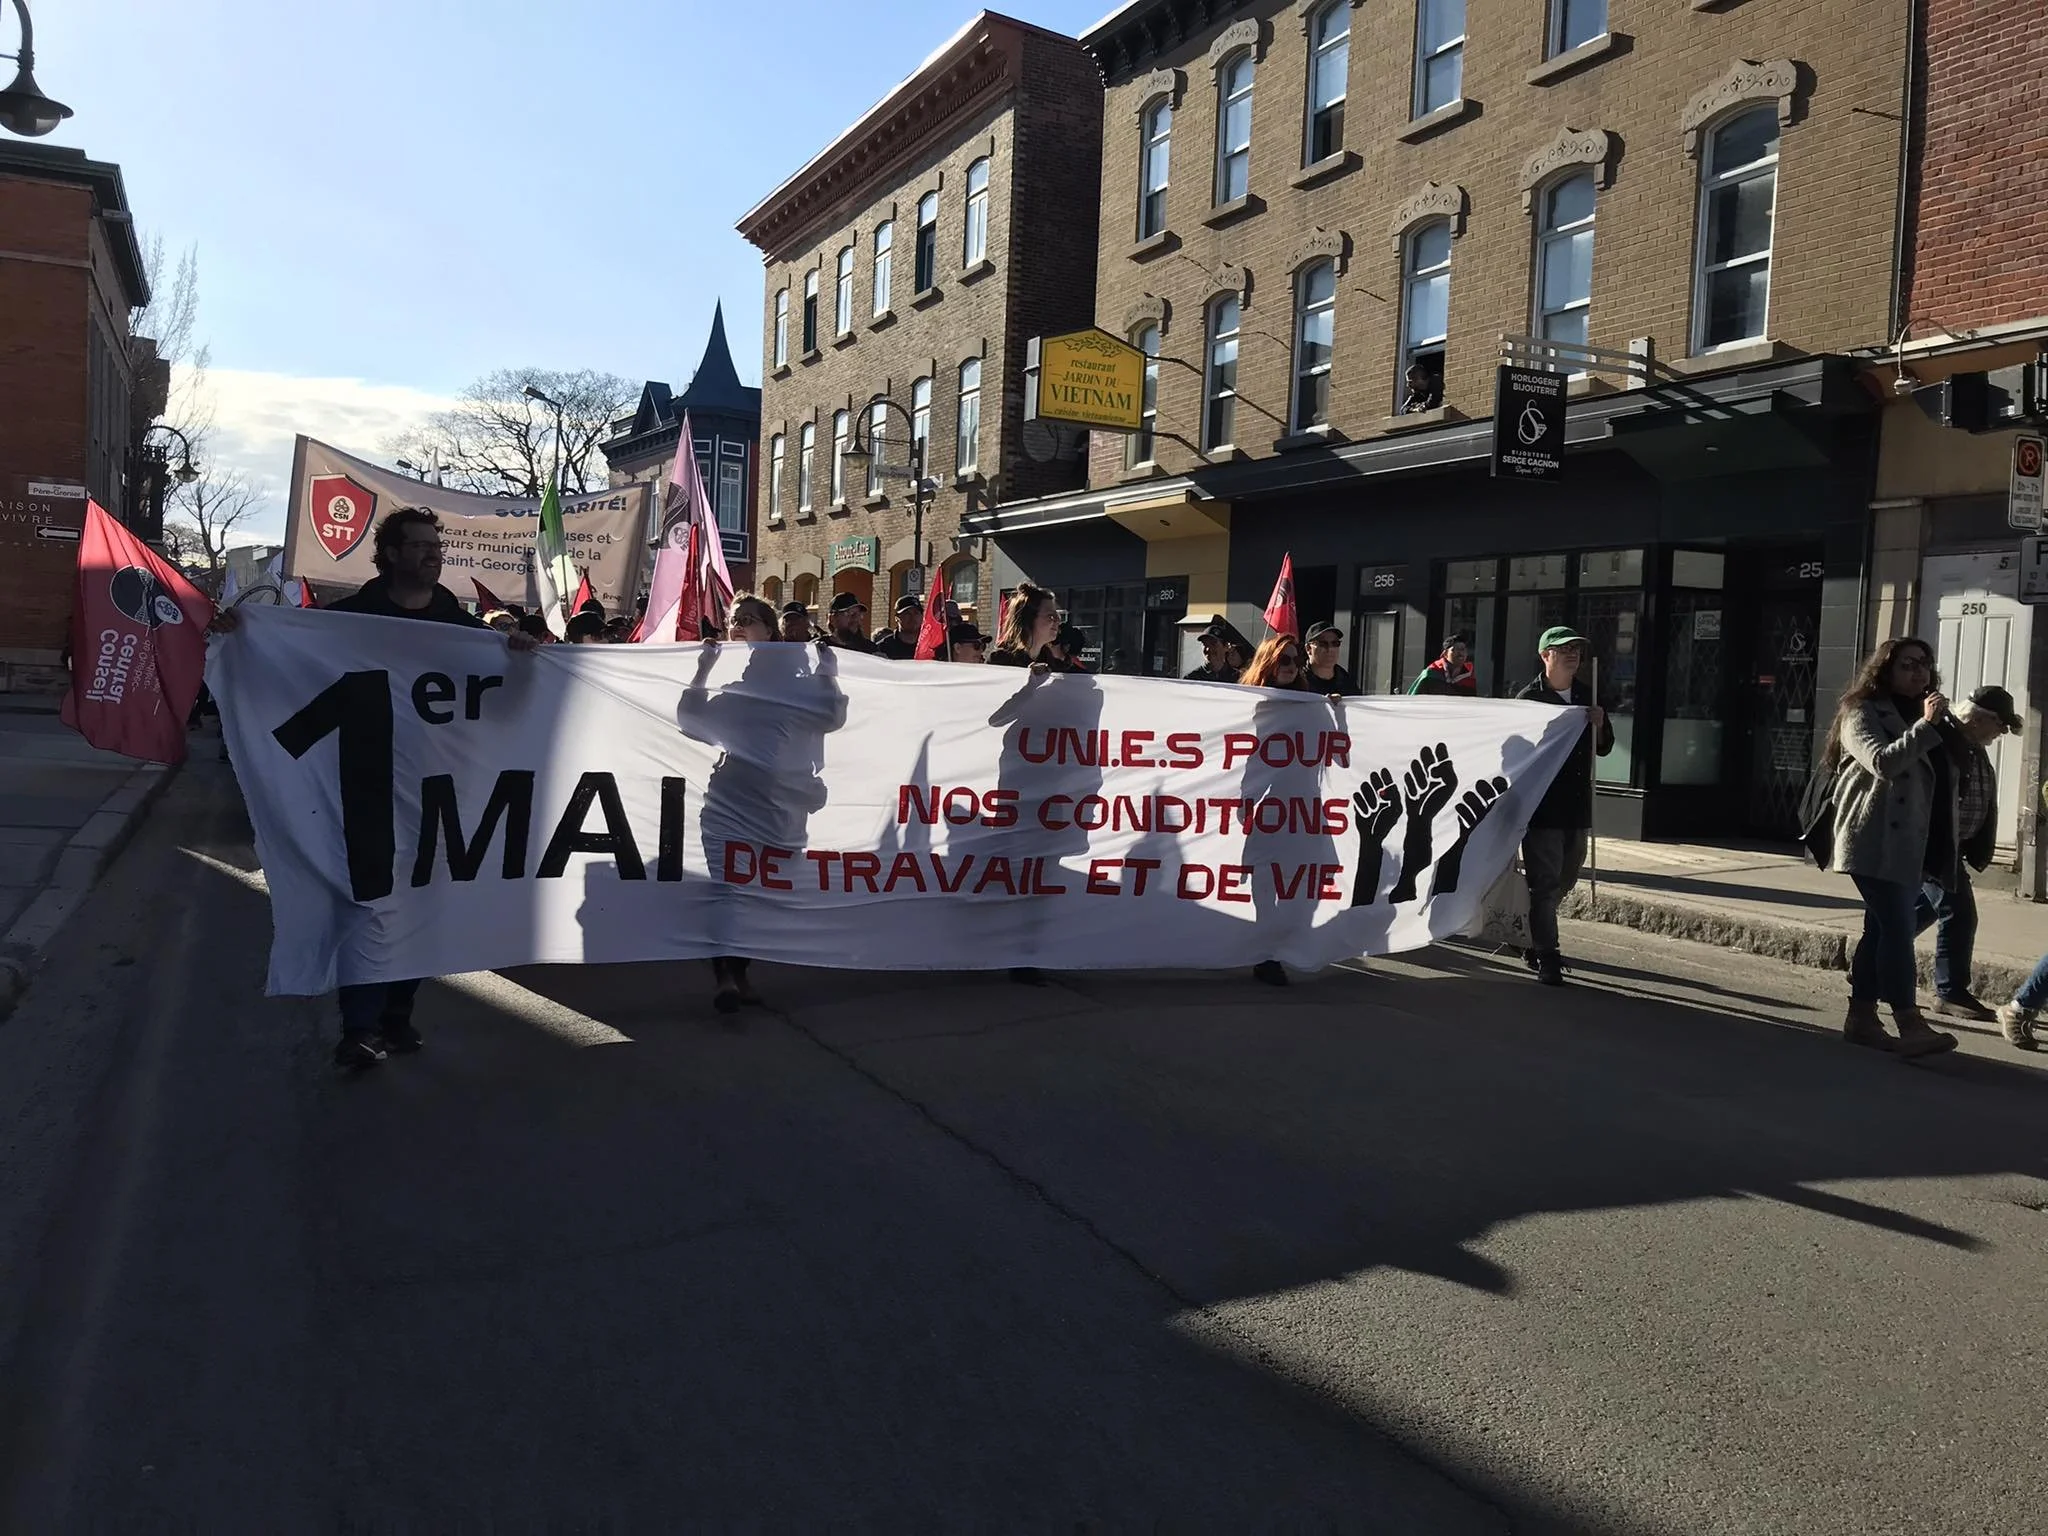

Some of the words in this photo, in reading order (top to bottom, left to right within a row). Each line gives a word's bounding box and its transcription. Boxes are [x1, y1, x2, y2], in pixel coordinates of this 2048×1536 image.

[1070, 359, 1116, 373] restaurant
[1063, 371, 1101, 385] JARDIN
[1105, 376, 1120, 388] DU
[1511, 373, 1560, 387] HORLOGERIE
[1513, 382, 1557, 396] BIJOUTERIE
[1051, 384, 1132, 410] VIETNAM
[1511, 449, 1551, 459] BIJOUTERIE
[1502, 455, 1527, 465] SERGE
[1527, 458, 1560, 469] GAGNON
[495, 496, 627, 517] SOLARITÉ!
[2, 513, 53, 524] VIVRE
[333, 512, 349, 520] CSN
[322, 523, 355, 541] STT
[472, 530, 499, 539] des
[597, 533, 611, 544] et
[478, 542, 537, 558] municip
[568, 547, 585, 559] de
[588, 548, 601, 560] la
[441, 554, 538, 575] Saint-George
[1800, 562, 1824, 578] 25
[1374, 574, 1395, 588] 256
[1160, 590, 1174, 600] 260
[1961, 603, 1987, 615] 250
[1018, 727, 1204, 769] UNI.E.S
[1223, 731, 1351, 770] POUR
[898, 784, 1020, 828] NOS
[1036, 795, 1350, 836] CONDITIONS
[411, 770, 686, 888] MAI
[723, 841, 793, 890] DE
[802, 848, 1066, 895] TRAVAIL
[1086, 858, 1160, 896] ET
[1176, 861, 1252, 903] DE
[1270, 861, 1344, 900] VIE
